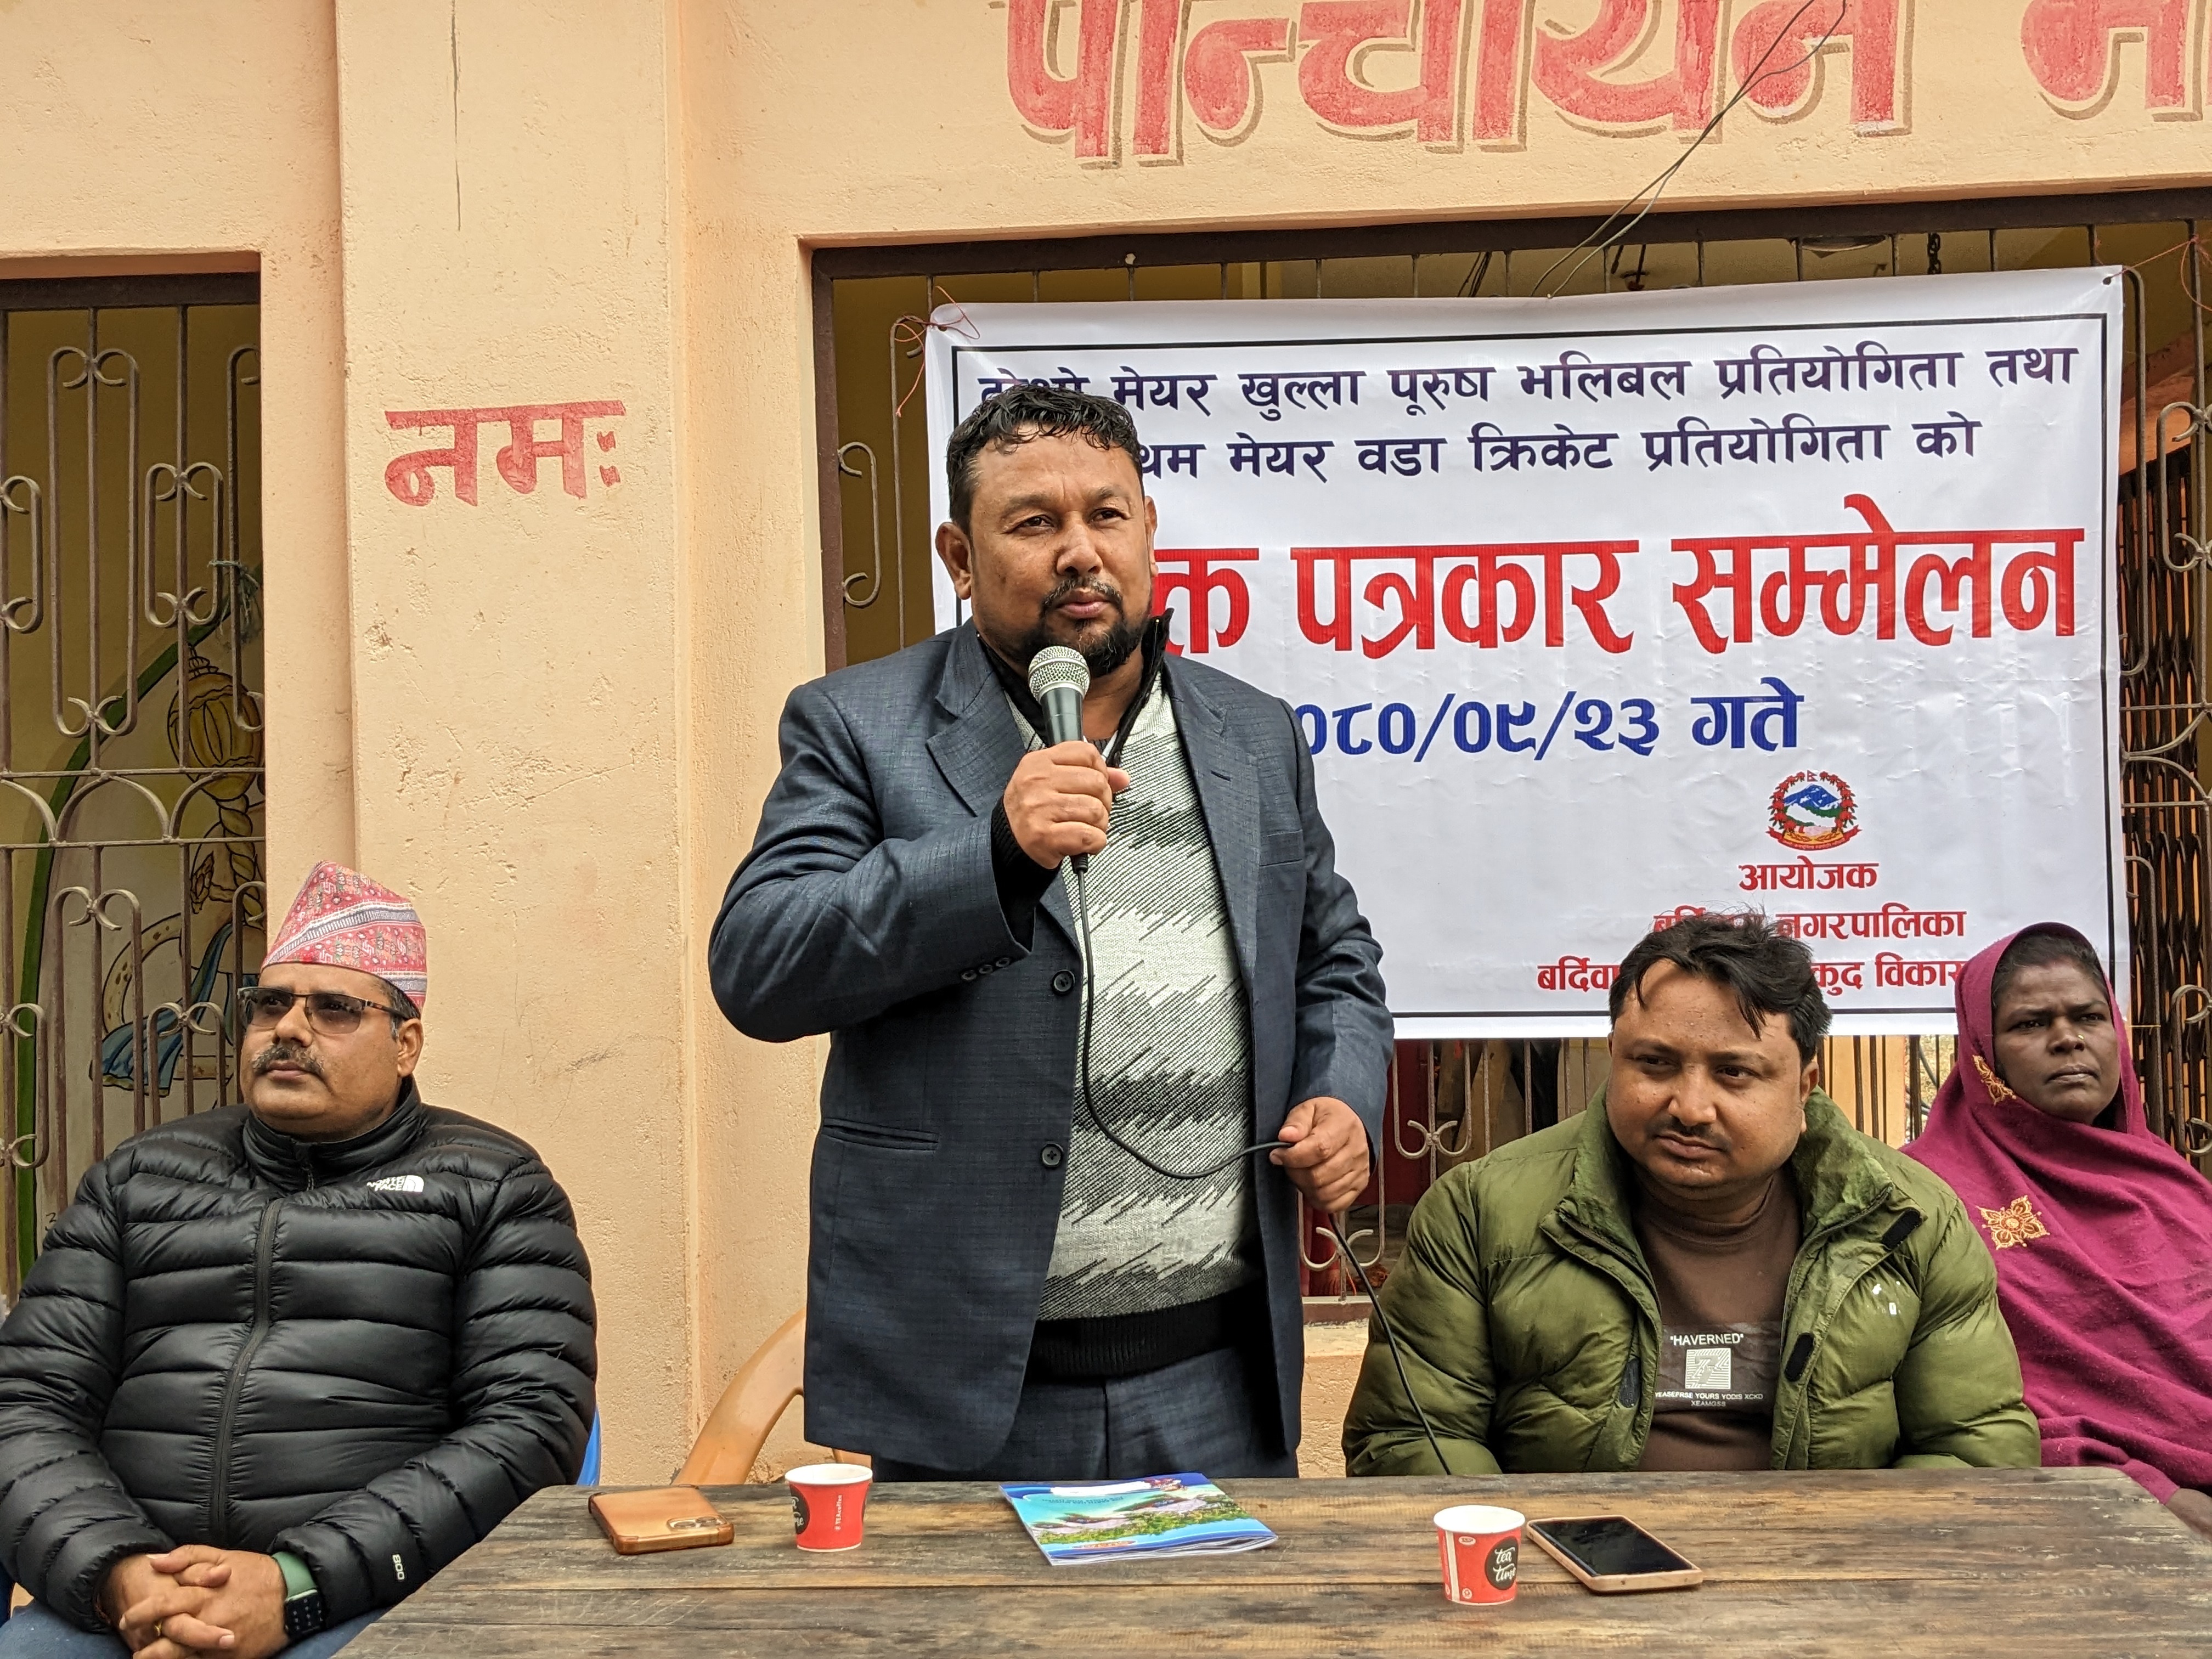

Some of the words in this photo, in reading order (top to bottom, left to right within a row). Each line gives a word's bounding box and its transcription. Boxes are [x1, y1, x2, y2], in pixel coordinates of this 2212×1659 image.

[1111, 366, 1217, 416] मेयर
[1237, 371, 1365, 421] खुल्ला
[1518, 351, 1692, 403] भलिबल
[1714, 341, 1964, 399] प्रतियोगिता
[1986, 347, 2078, 387] तथा
[385, 400, 626, 507] नमः
[1140, 444, 1206, 479] थम
[1227, 432, 1335, 483] मेयर
[1354, 438, 1447, 476] वडा
[1467, 422, 1620, 472] क्रिकेट
[1641, 413, 1891, 472] प्रतियोगिता
[1912, 411, 1982, 457] को
[1152, 548, 1259, 656] क
[1290, 539, 1640, 659] पत्रकार
[1671, 494, 2085, 654] सम्मेलन
[1295, 692, 1659, 761] ०८०/०९/२३
[1691, 677, 1804, 751] गते
[1739, 854, 1879, 890] आयोजक
[1775, 902, 1966, 939] नगरपालिका
[1812, 961, 1865, 996] कुद
[392, 1554, 405, 1580] 800
